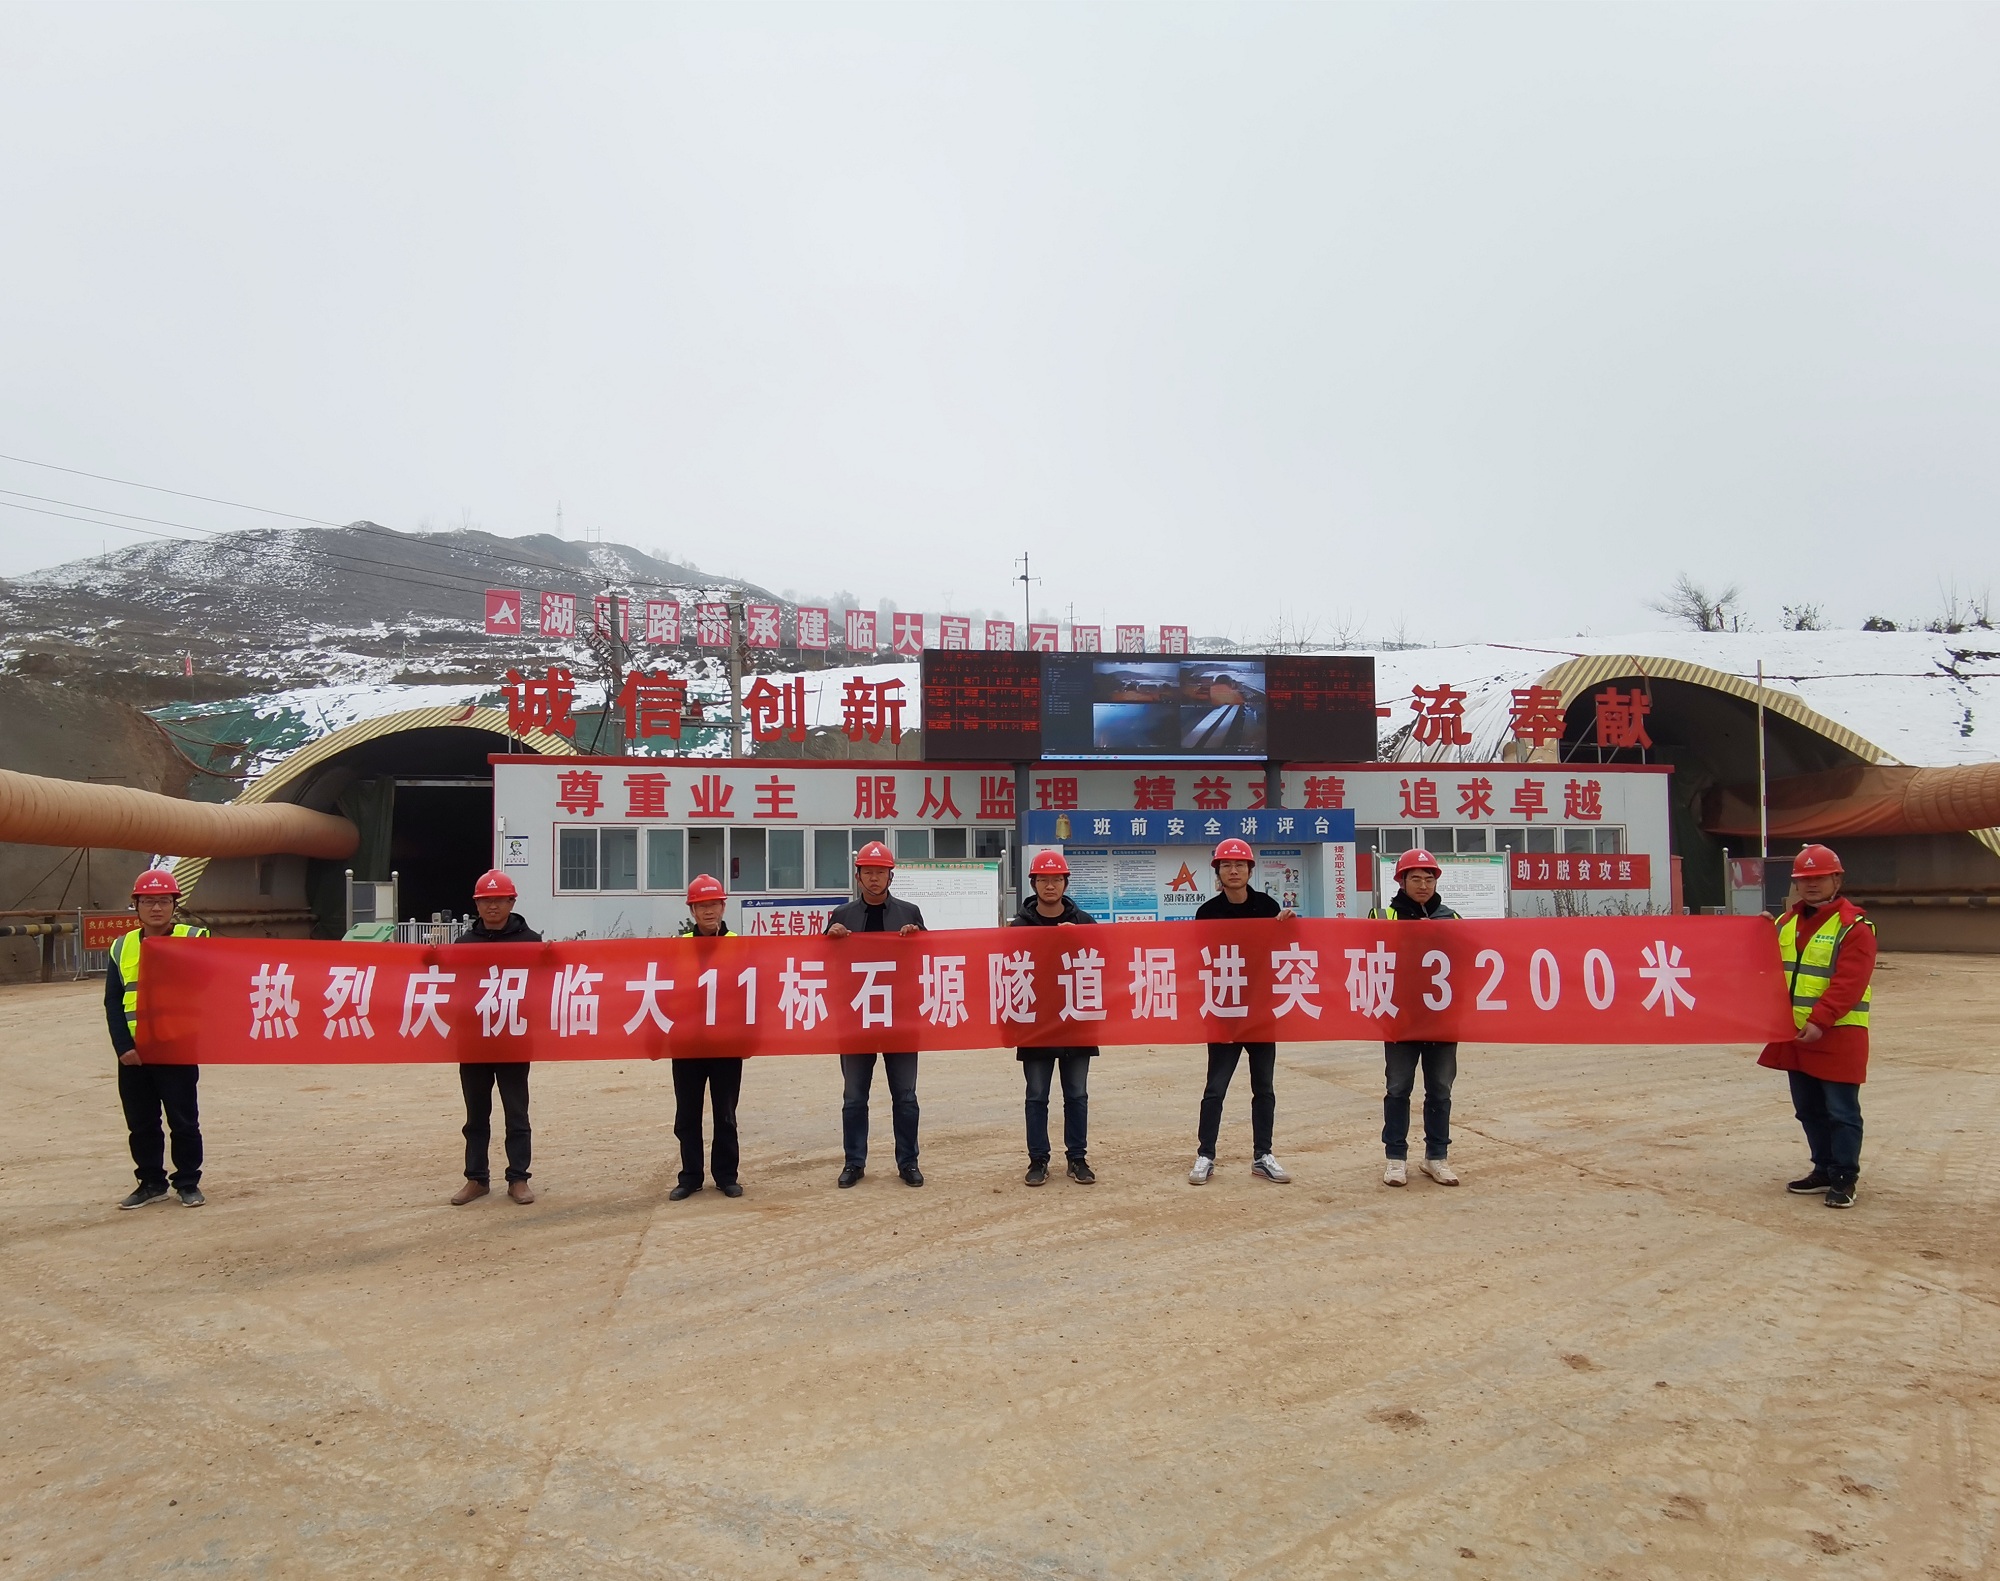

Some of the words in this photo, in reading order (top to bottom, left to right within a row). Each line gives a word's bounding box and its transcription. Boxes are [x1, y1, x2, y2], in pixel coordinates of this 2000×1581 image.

[501, 667, 907, 745] 诚信创新
[556, 770, 798, 818] 尊重业主
[853, 775, 1078, 819] 服从监理
[1399, 777, 1603, 821] 追求卓越
[1093, 817, 1331, 836] 班前安全讲评台
[1334, 845, 1346, 908] 提高职工安全意识
[1517, 859, 1632, 882] 助力脱贫攻坚
[1163, 893, 1206, 902] 湖南路桥
[88, 918, 144, 930] 热烈欢迎各级
[751, 909, 833, 936] 小车停放
[249, 939, 1696, 1041] 热烈庆祝临大11标石塬隧道掘进突破3200米
